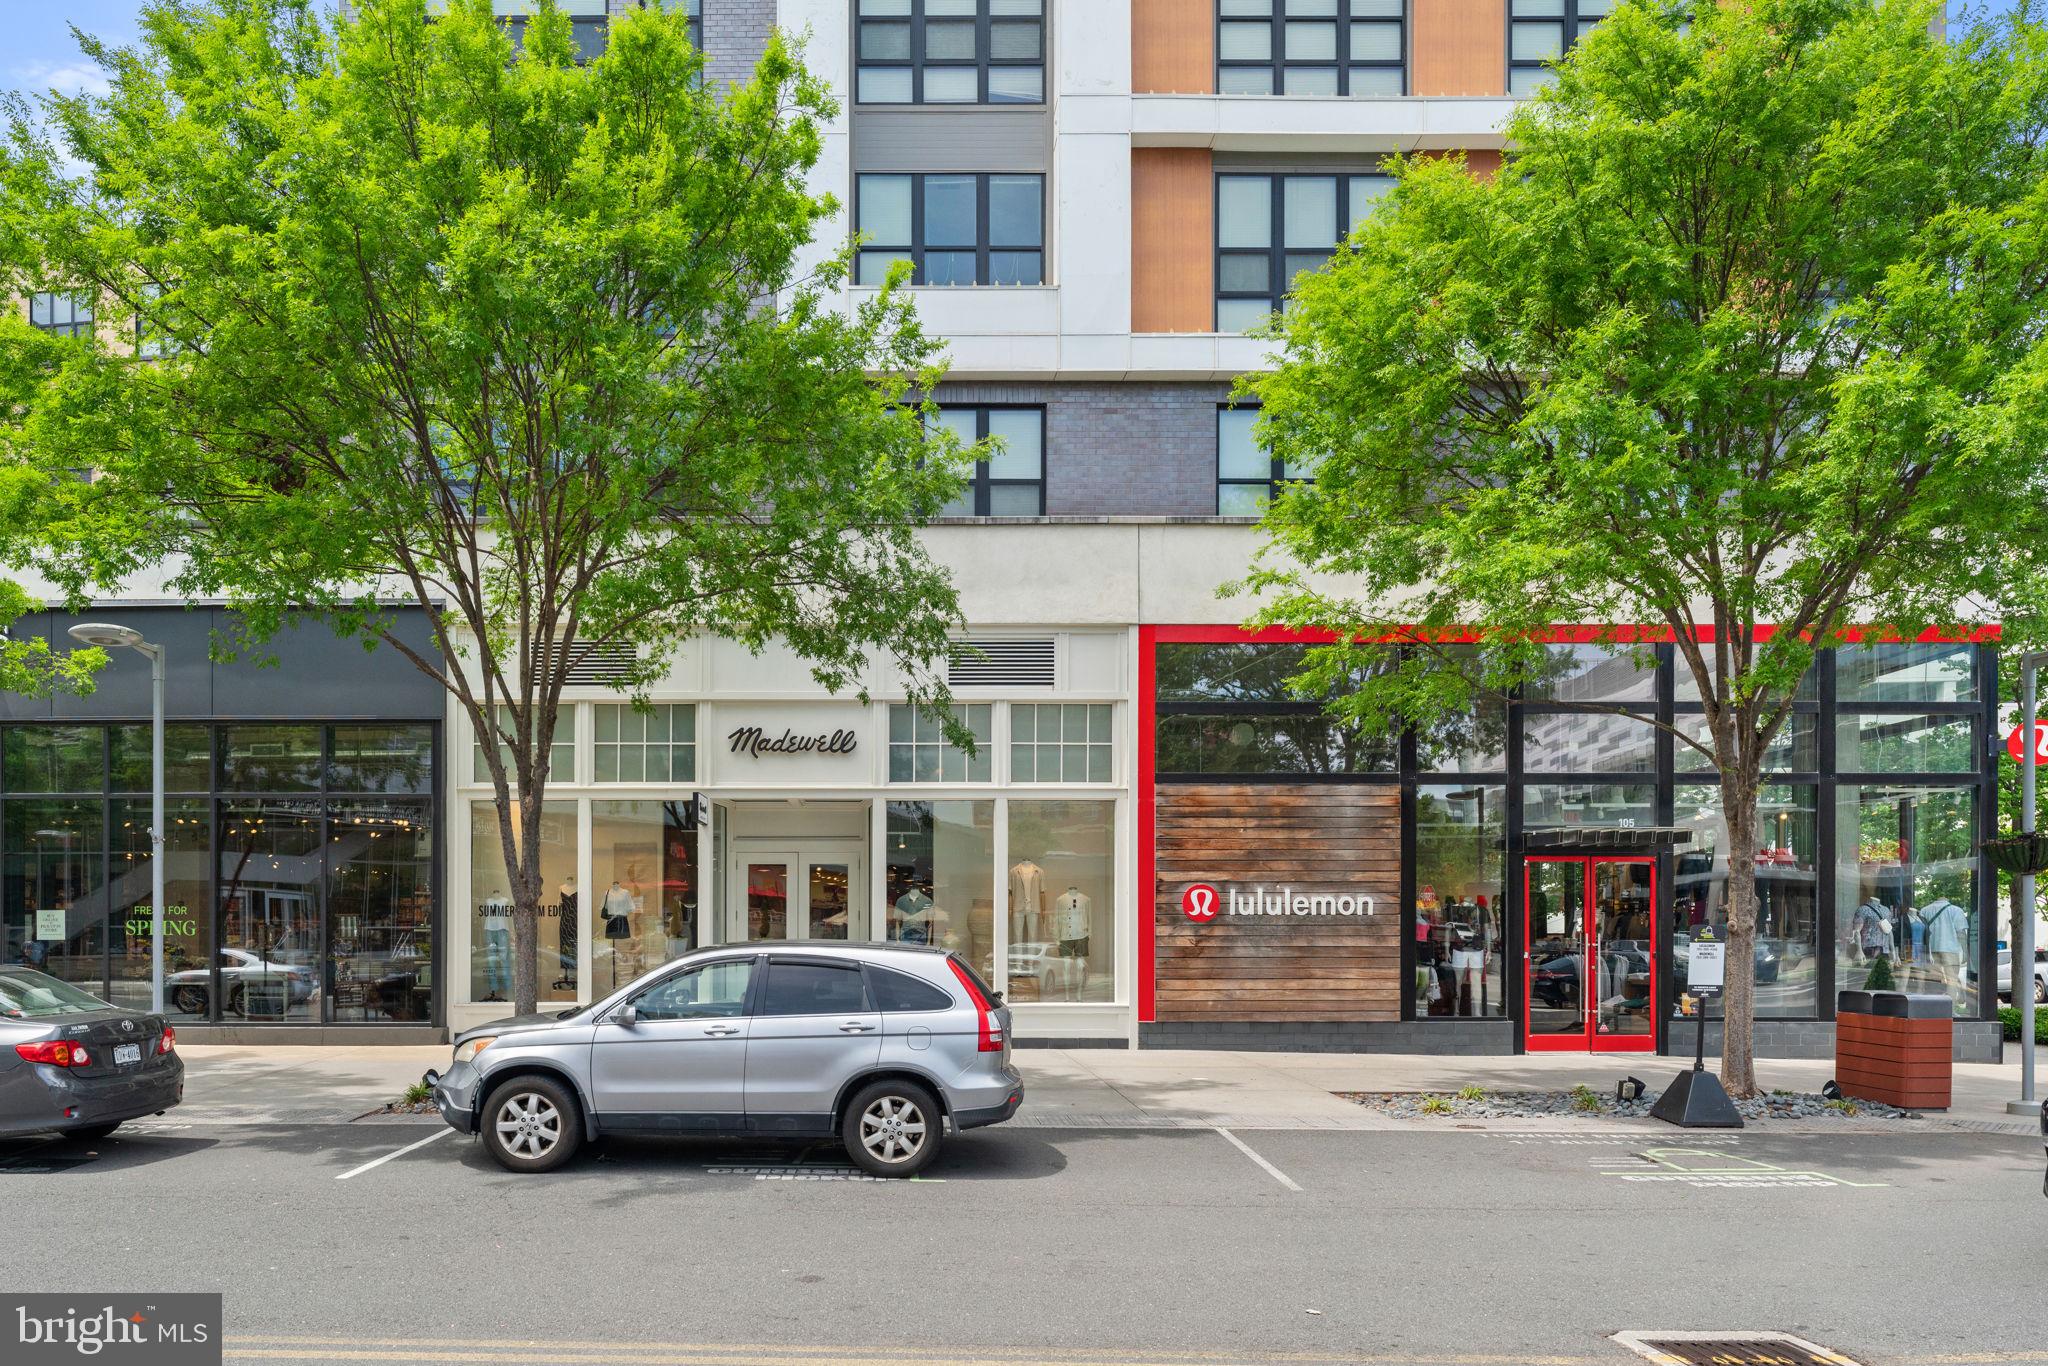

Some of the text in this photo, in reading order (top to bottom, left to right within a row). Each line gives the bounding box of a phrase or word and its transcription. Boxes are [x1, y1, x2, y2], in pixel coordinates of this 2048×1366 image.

[727, 727, 857, 759] Madewell
[1619, 818, 1635, 828] 105
[1229, 888, 1374, 916] lululemon
[168, 905, 188, 915] FOR
[479, 905, 515, 917] SUMMER
[548, 905, 564, 917] EDI
